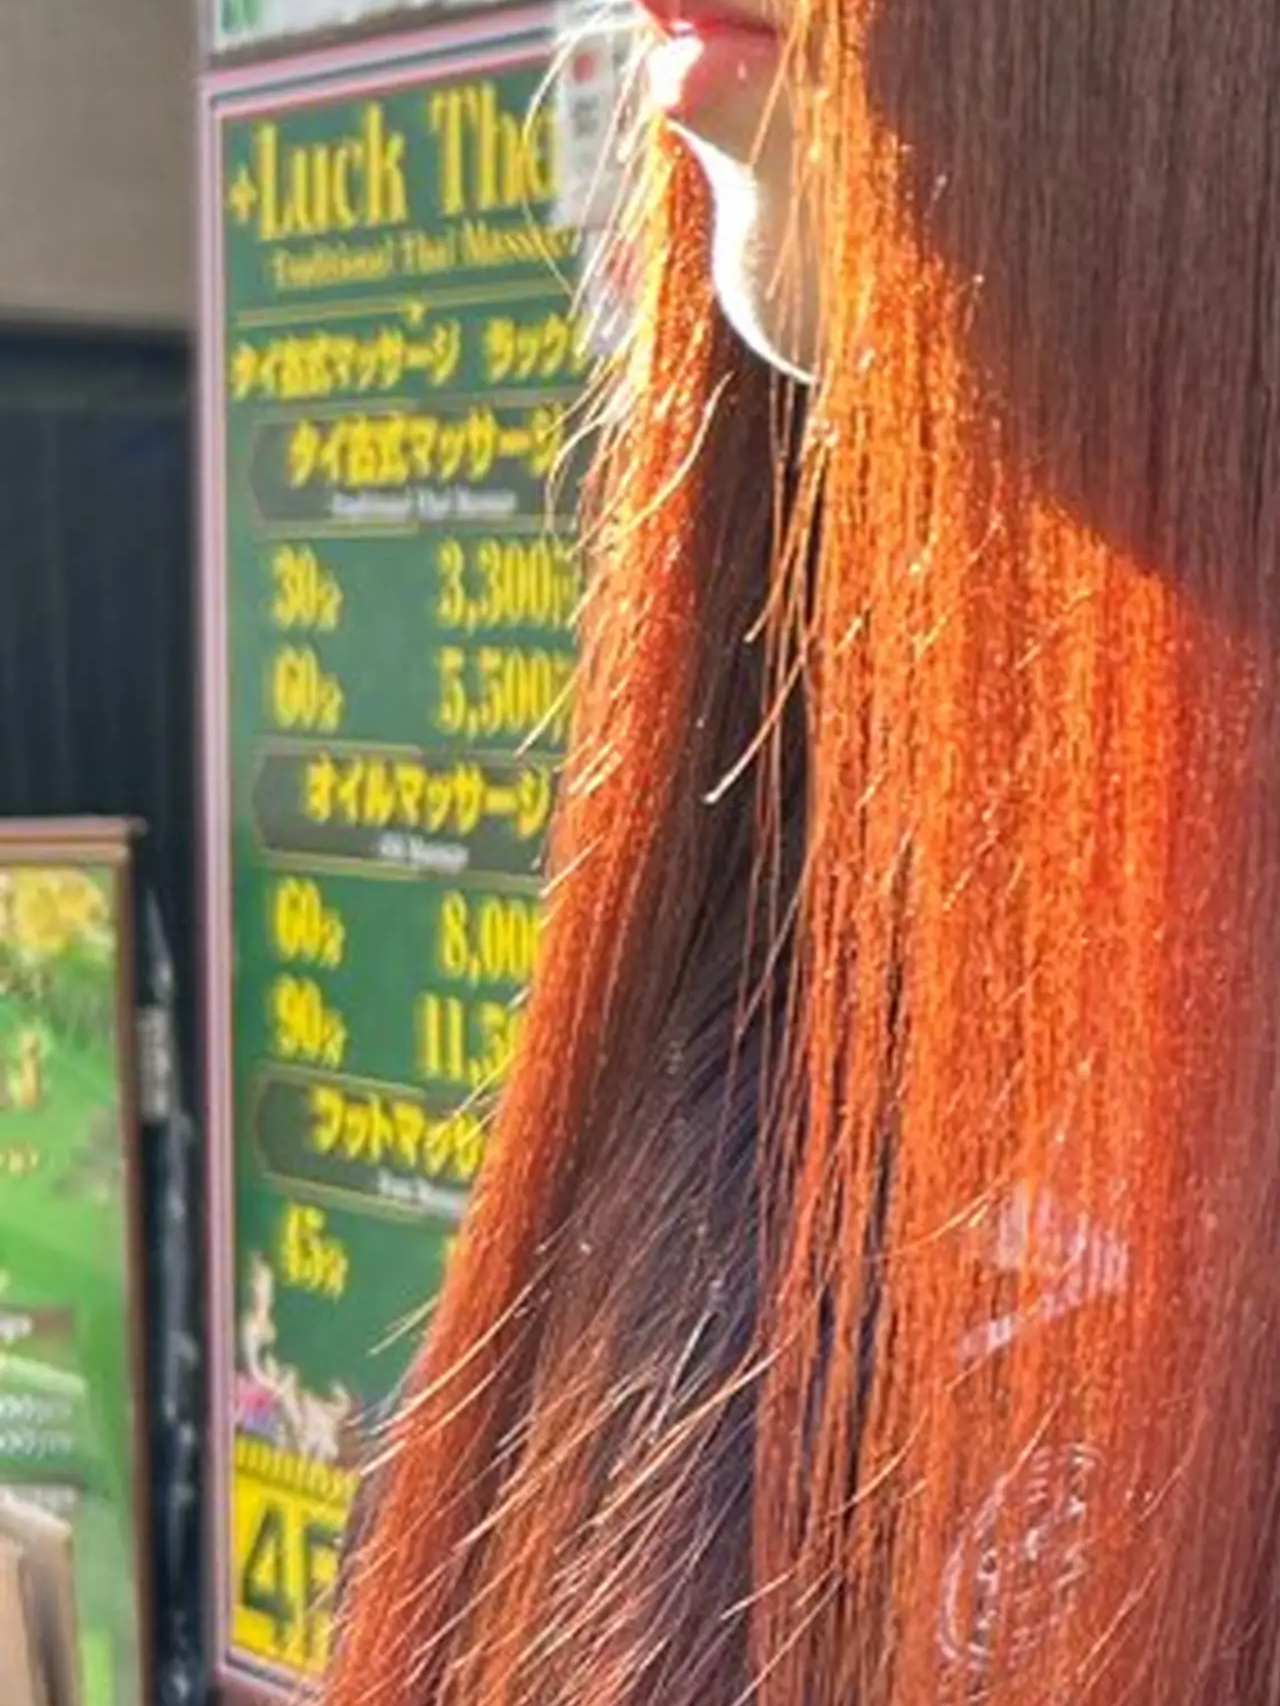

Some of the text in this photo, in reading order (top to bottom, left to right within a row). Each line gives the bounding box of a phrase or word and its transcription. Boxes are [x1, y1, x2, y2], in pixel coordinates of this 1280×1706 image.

[257, 101, 407, 242] Luck
[304, 751, 552, 840] オイルマッサージ
